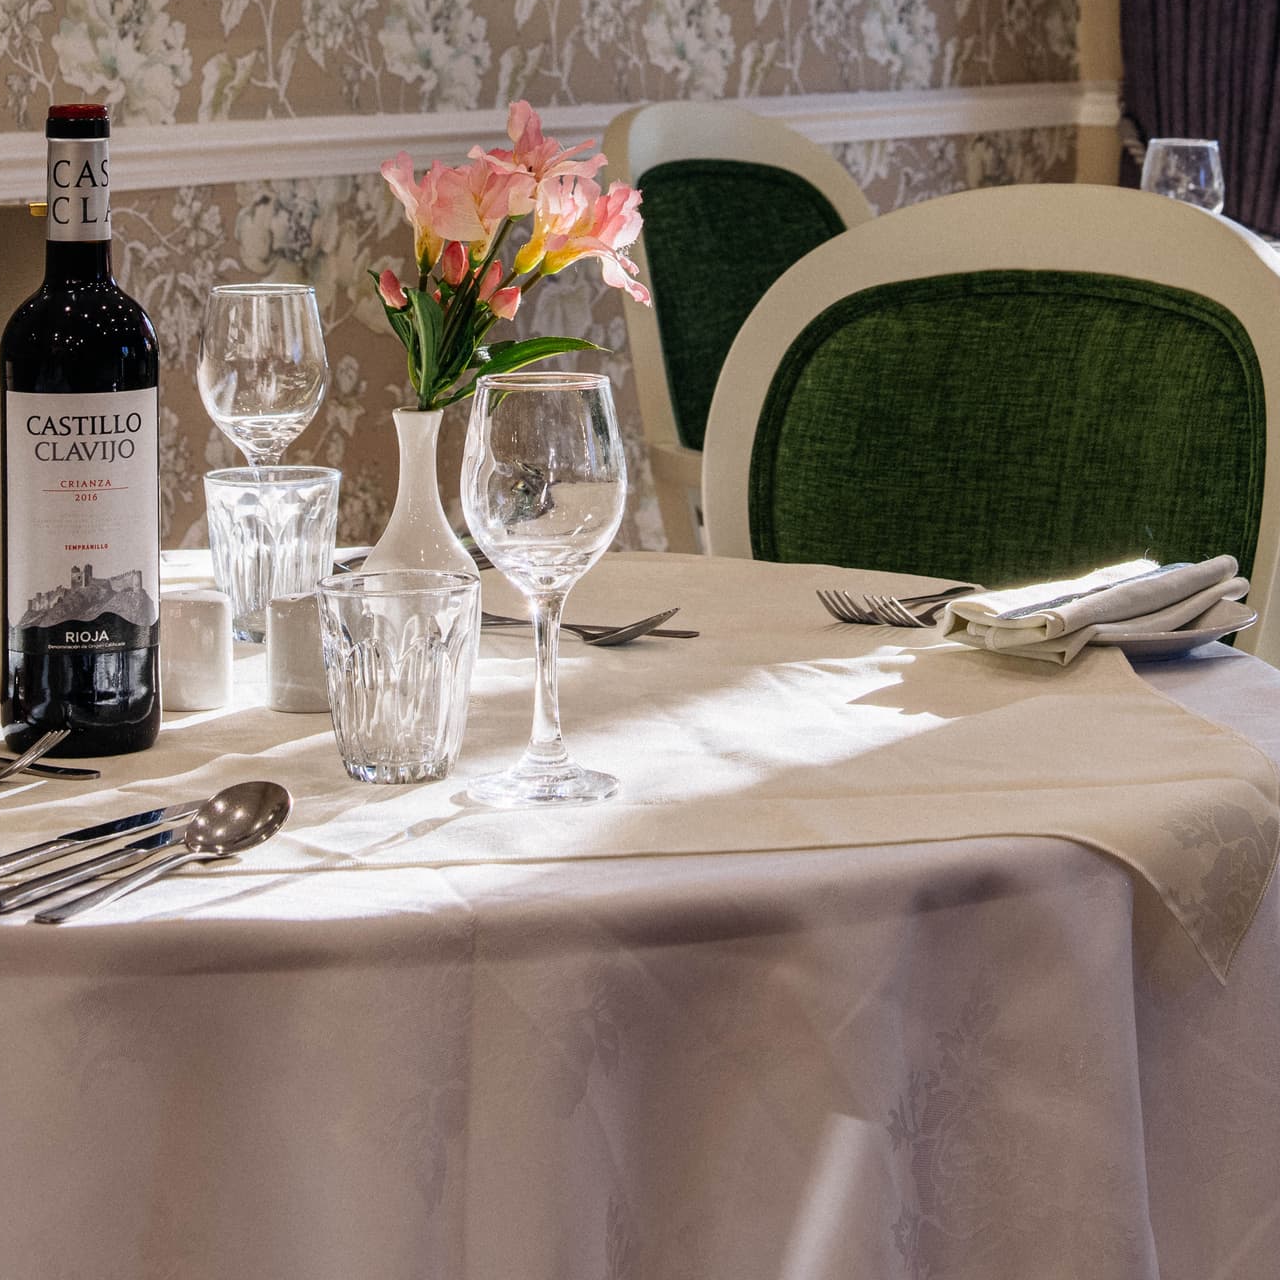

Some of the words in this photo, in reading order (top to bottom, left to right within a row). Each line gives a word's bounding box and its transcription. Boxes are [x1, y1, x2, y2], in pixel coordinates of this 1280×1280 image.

[27, 412, 142, 436] CASTILLO
[35, 438, 135, 463] CLAVIJO
[60, 479, 112, 488] CRIANZA
[75, 493, 98, 501] 2016
[65, 543, 108, 551] TEMPRANILLO
[65, 630, 109, 643] RIOJA
